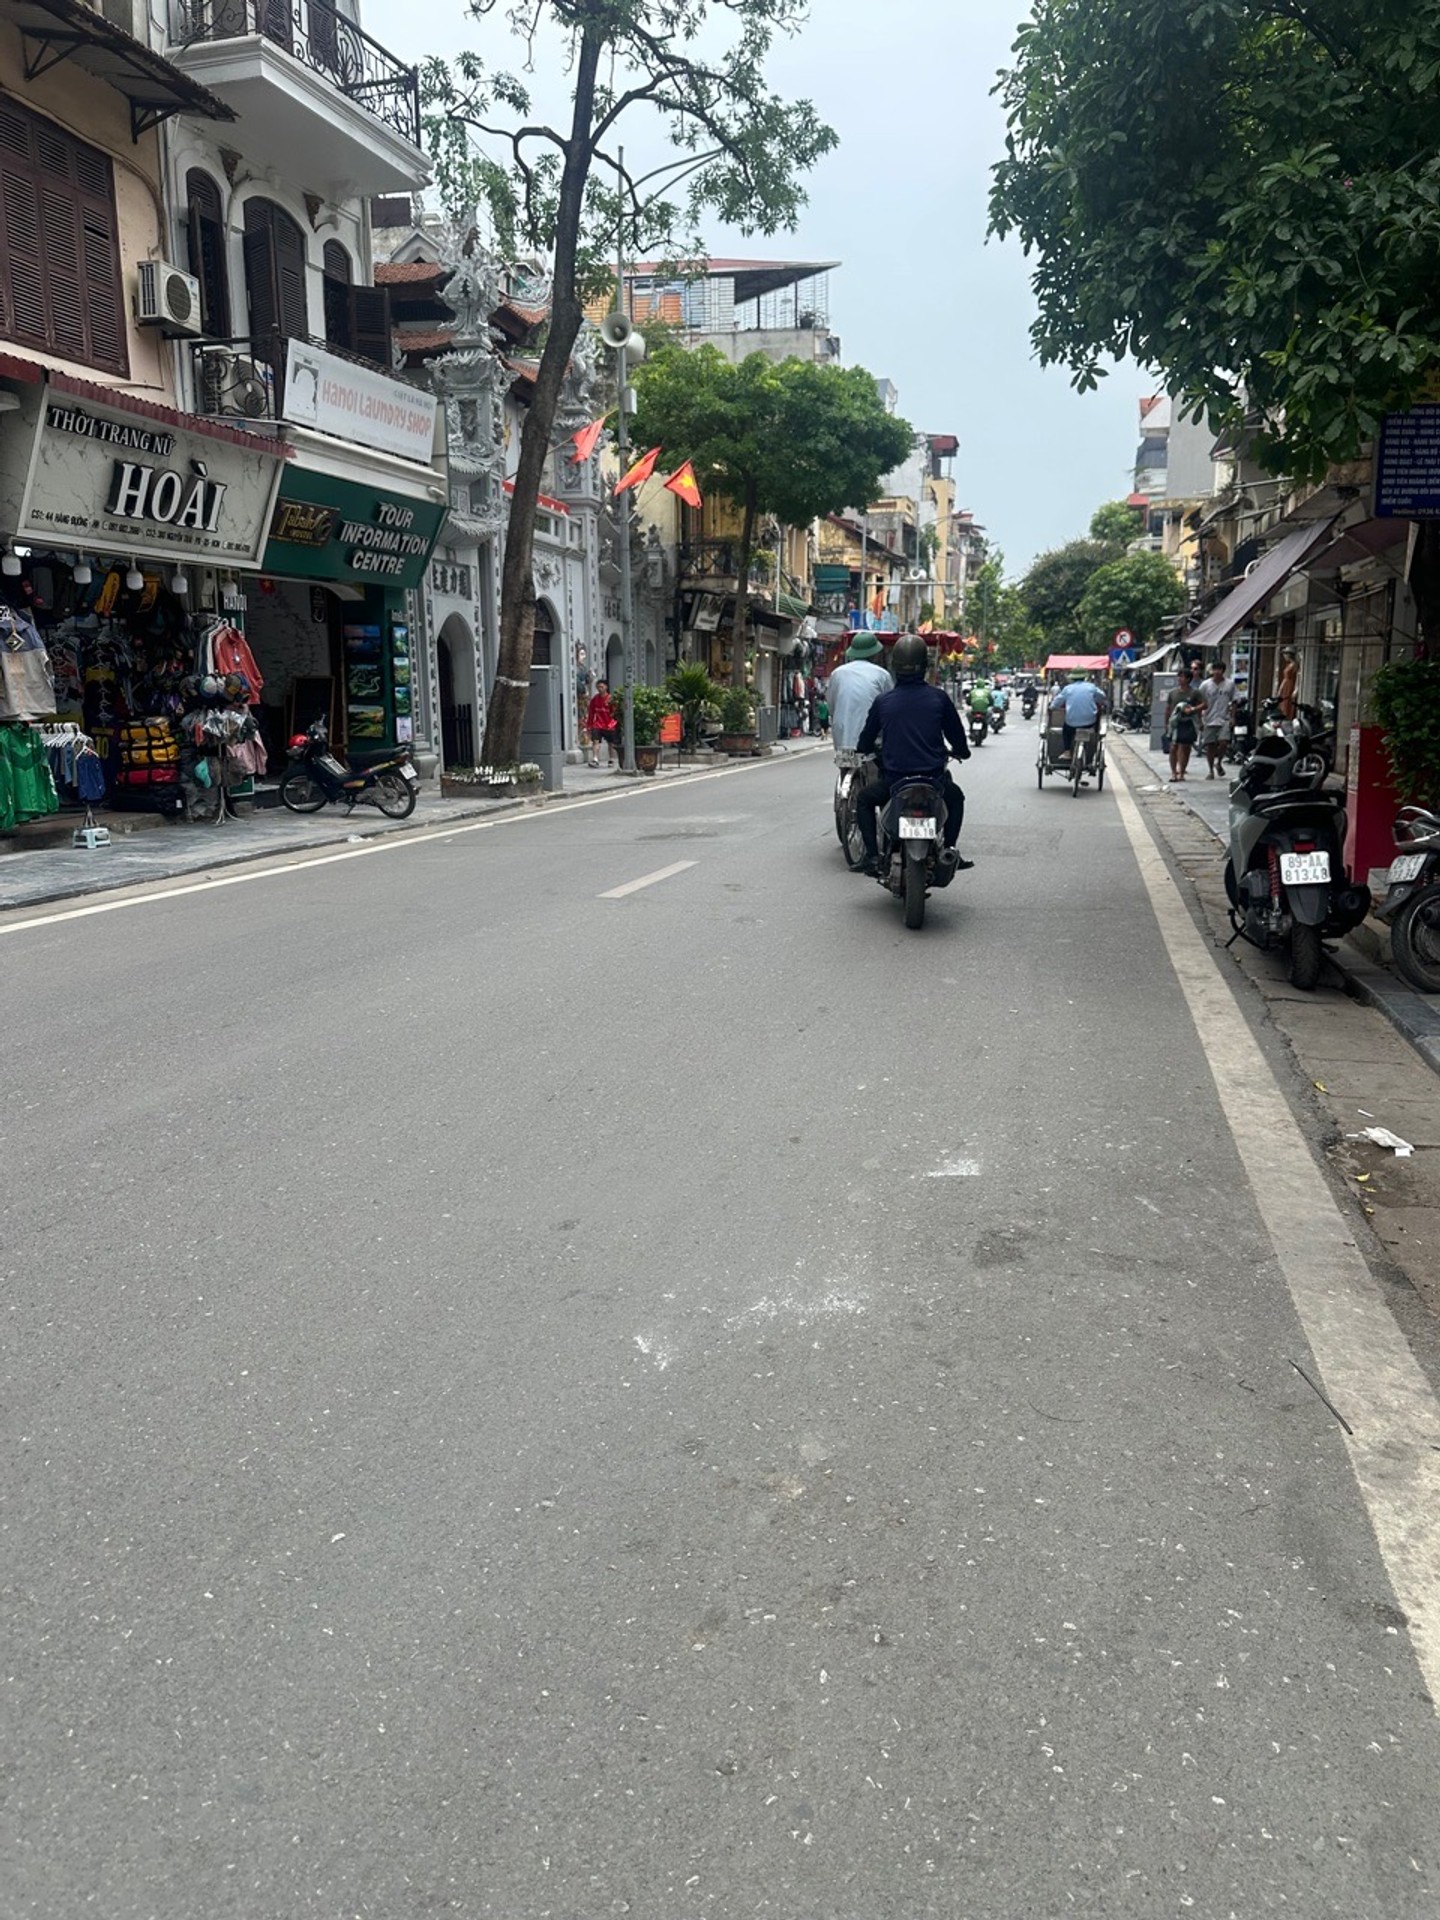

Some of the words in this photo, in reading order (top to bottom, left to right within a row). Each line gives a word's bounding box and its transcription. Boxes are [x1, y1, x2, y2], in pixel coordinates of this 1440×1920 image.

[52, 408, 95, 437] THỜI
[99, 421, 150, 450] TRANG
[406, 410, 432, 438] SHOP
[111, 461, 227, 533] HOÀI
[378, 502, 414, 529] TOUR
[340, 521, 430, 556] INFORMATION
[352, 550, 406, 575] CENTRE
